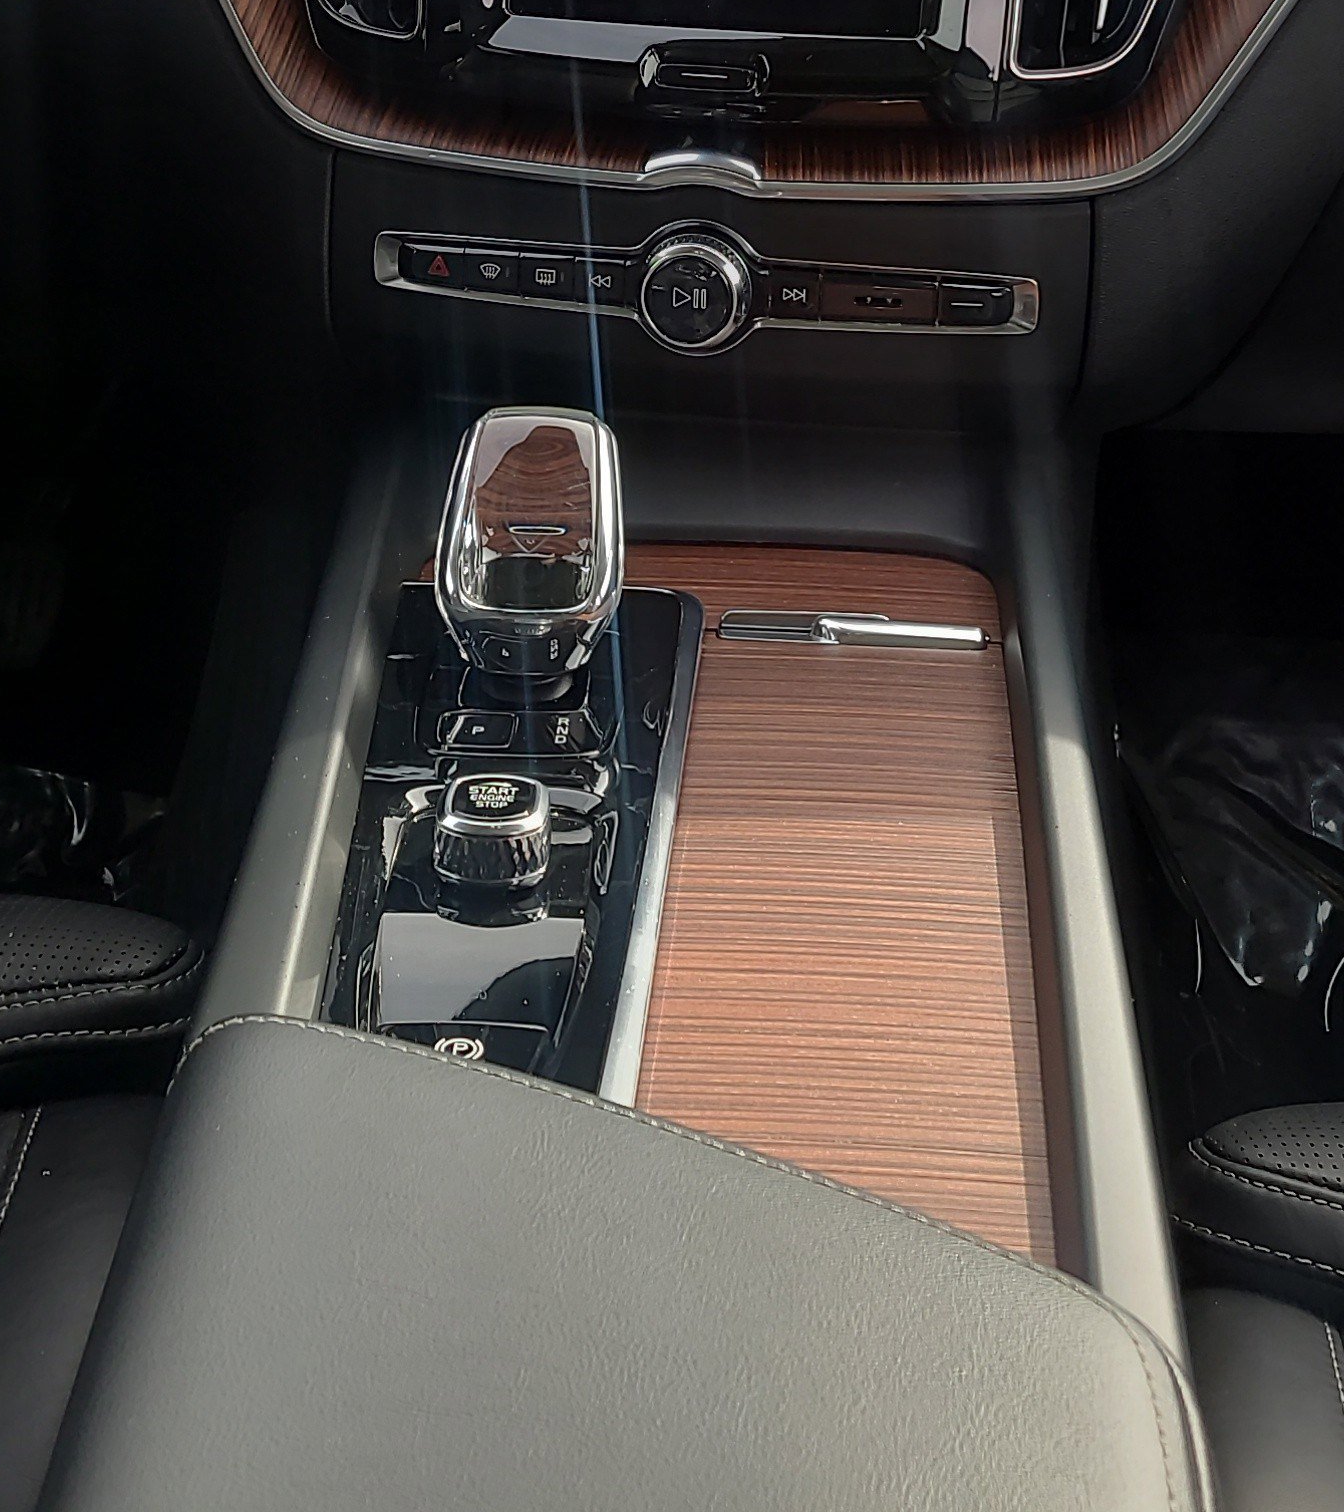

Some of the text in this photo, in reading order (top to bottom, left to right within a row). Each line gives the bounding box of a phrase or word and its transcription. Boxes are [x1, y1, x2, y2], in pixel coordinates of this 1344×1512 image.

[472, 726, 485, 735] P
[468, 785, 520, 796] START
[469, 793, 515, 802] ENGINE
[476, 800, 508, 808] STOP
